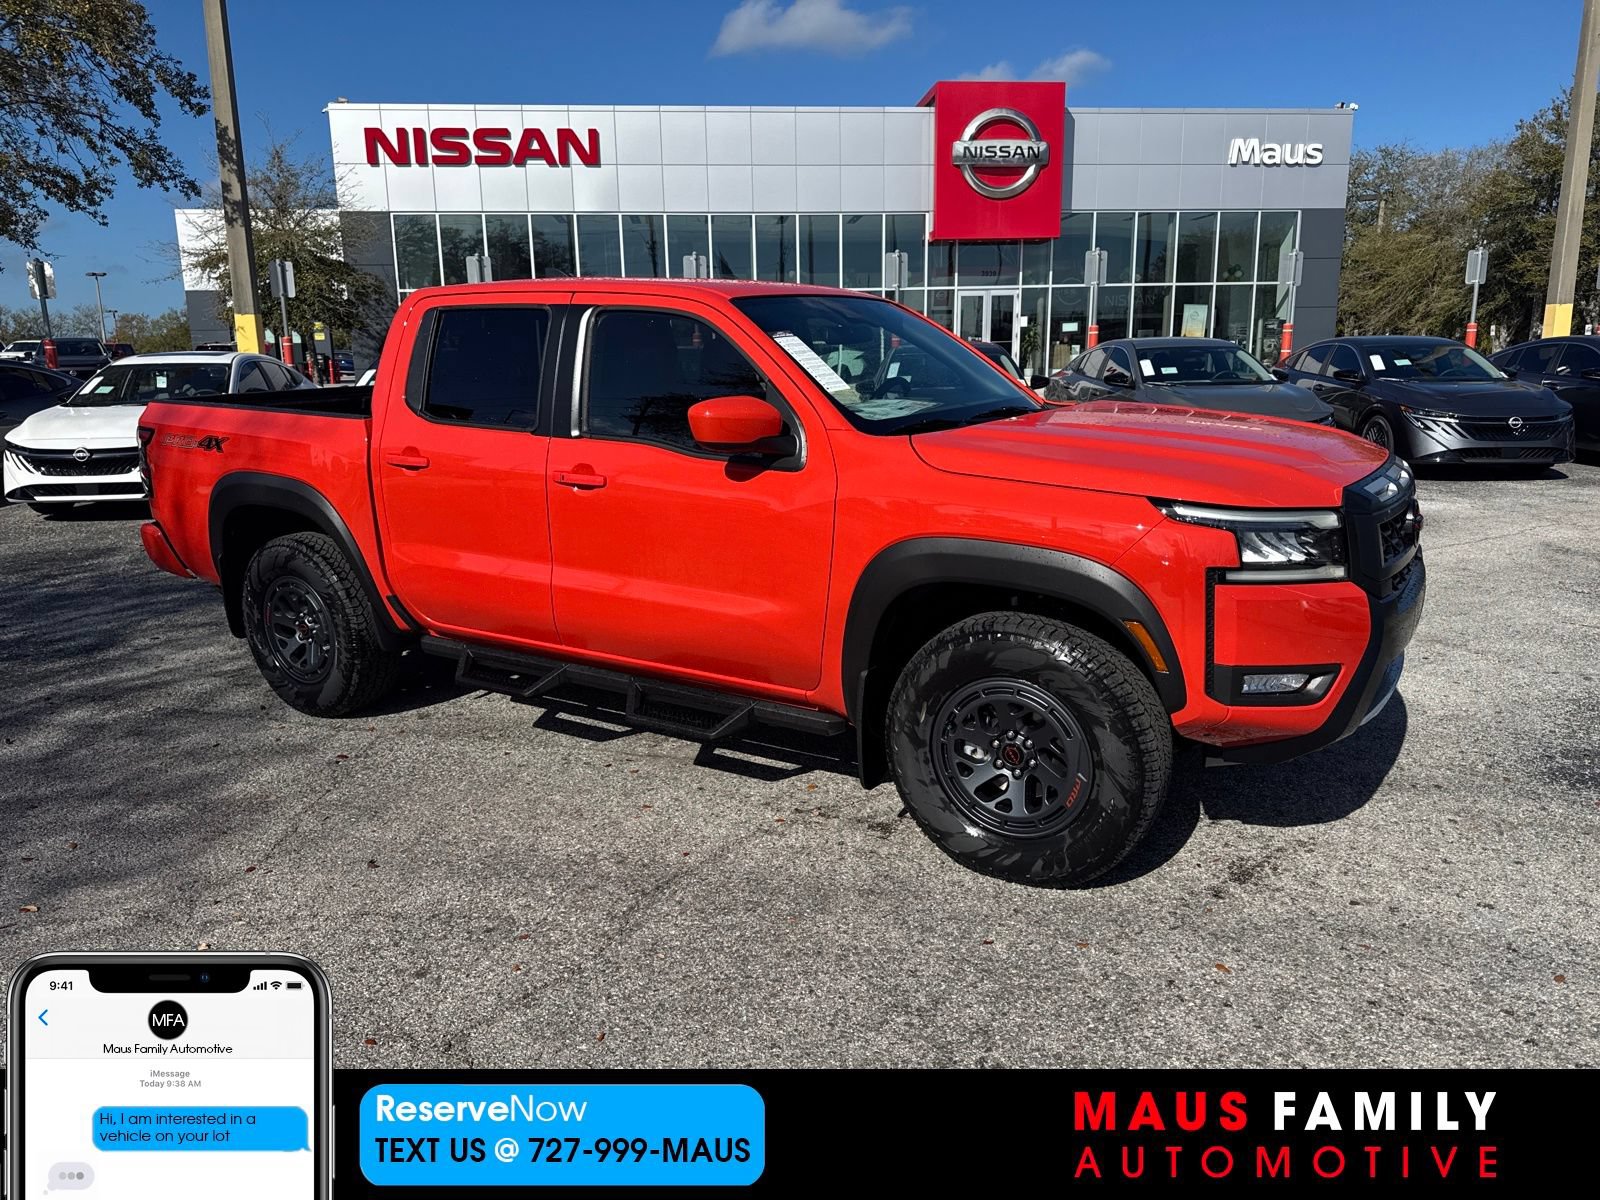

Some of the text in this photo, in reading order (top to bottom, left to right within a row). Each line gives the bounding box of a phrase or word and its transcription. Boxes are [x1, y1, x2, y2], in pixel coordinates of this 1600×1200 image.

[363, 127, 602, 168] NISSAN
[963, 145, 1040, 159] NISSAN
[1227, 137, 1324, 167] Maus
